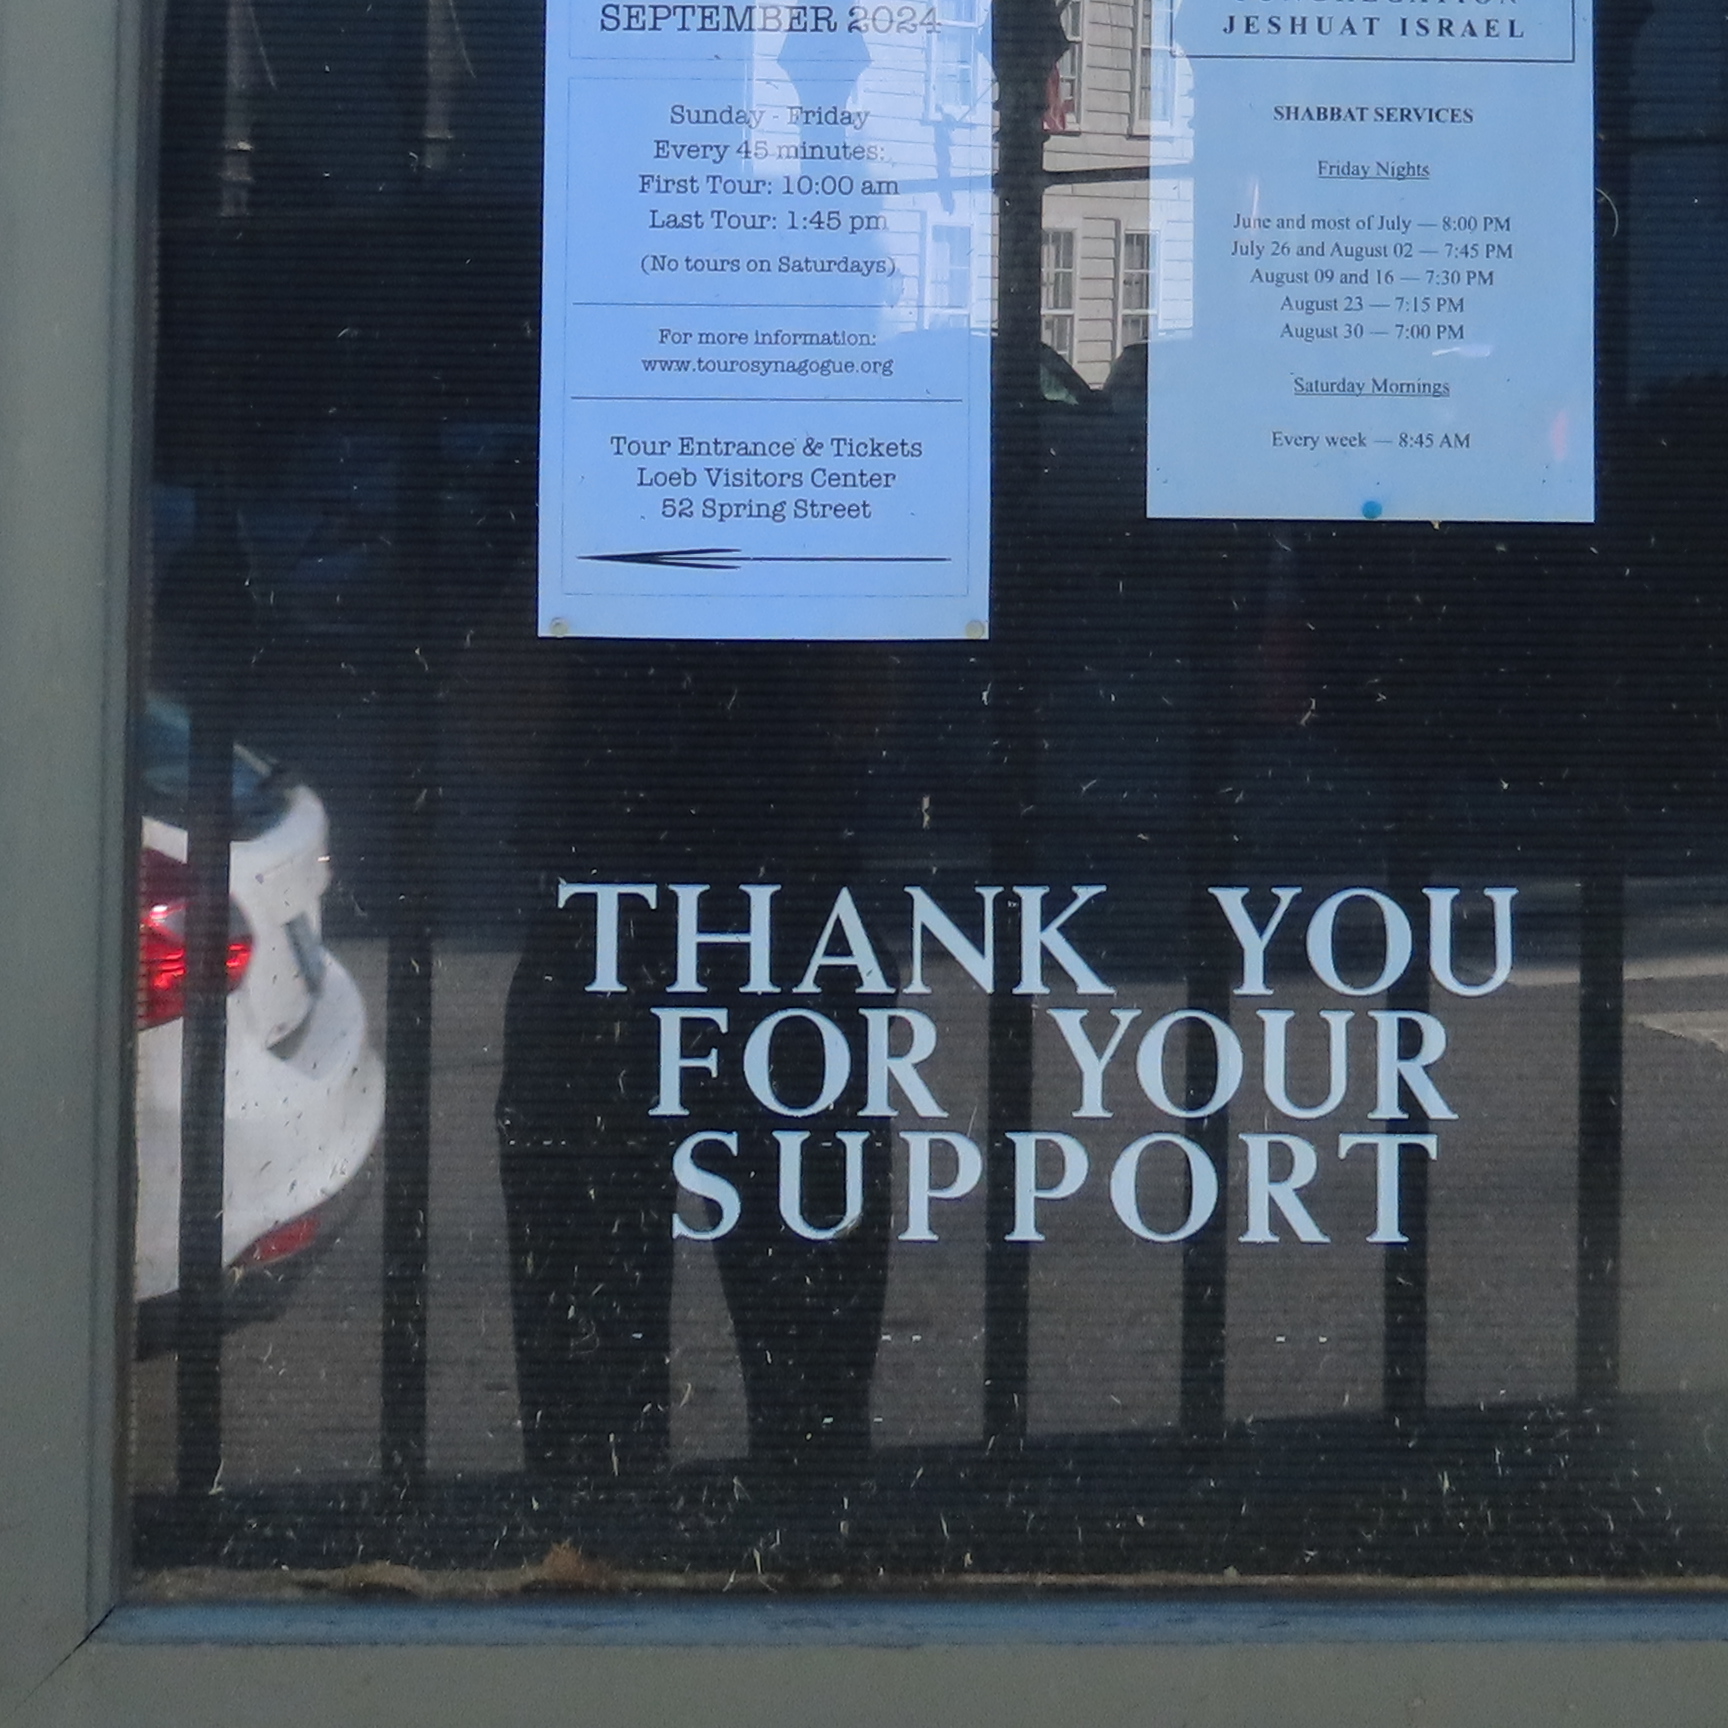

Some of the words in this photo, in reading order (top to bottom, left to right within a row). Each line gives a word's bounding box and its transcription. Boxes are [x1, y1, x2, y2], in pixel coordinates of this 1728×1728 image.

[600, 4, 837, 34] SEPTEMBER
[848, 6, 941, 34] 2024
[1223, 15, 1381, 36] JESHUAT
[1400, 18, 1525, 38] ISRAEL
[670, 105, 765, 129] Sunday
[787, 106, 870, 130] Friday
[1273, 106, 1369, 123] SHABBAT
[1374, 107, 1474, 124] SERVICES
[653, 140, 729, 163] Every
[736, 140, 769, 160] 45
[777, 141, 885, 160] minutes:
[1318, 161, 1370, 180] Friday
[1376, 161, 1430, 180] Nights
[639, 175, 699, 196] First
[706, 175, 772, 196] Tour:
[782, 175, 854, 196] 10:00
[861, 179, 900, 196] am
[649, 210, 704, 230] Last
[710, 210, 777, 230] Tour:
[786, 210, 842, 230] 1:45
[849, 214, 888, 235] pm
[1233, 214, 1271, 232] June
[1276, 214, 1306, 230] and
[1311, 217, 1350, 231] most
[1355, 214, 1375, 231] of
[1376, 214, 1412, 234] July
[1442, 215, 1478, 233] 8:00
[1483, 216, 1511, 233] PM
[1231, 240, 1265, 259] July
[1270, 241, 1291, 257] 26
[1296, 241, 1326, 258] and
[1330, 241, 1389, 261] August
[1393, 242, 1413, 258] 02
[1444, 243, 1480, 259] 7:45
[1485, 243, 1513, 259] PM
[640, 253, 679, 275] (No
[684, 257, 740, 274] tours
[746, 259, 771, 274] on
[778, 254, 897, 276] Saturdays)
[1250, 268, 1309, 287] August
[1314, 269, 1335, 285] 09
[1340, 269, 1369, 285] and
[1376, 269, 1394, 285] 16
[1425, 270, 1461, 286] 7:30
[1466, 270, 1494, 286] PM
[1280, 296, 1338, 315] August
[1343, 296, 1363, 312] 23
[1395, 296, 1430, 313] 7:15
[1436, 297, 1464, 313] PM
[659, 329, 692, 346] For
[698, 332, 748, 346] more
[754, 329, 876, 346] information:
[1280, 323, 1338, 342] August
[1343, 324, 1363, 339] 30
[1395, 324, 1430, 340] 7:00
[1436, 324, 1464, 340] PM
[641, 356, 893, 377] www.tourosynagogue.org
[1293, 377, 1365, 397] Saturday
[1371, 378, 1450, 397] Mornings
[610, 436, 672, 457] Tour
[678, 436, 795, 457] Entrance
[802, 438, 824, 457] &
[830, 437, 922, 458] Tickets
[1272, 432, 1320, 450] Every
[1325, 431, 1367, 448] week
[1398, 432, 1434, 449] 8:45
[1439, 432, 1470, 449] AM
[637, 467, 697, 488] Loeb
[705, 467, 803, 488] Visitors
[810, 467, 896, 488] Center
[661, 498, 694, 519] 52
[702, 498, 786, 522] Spring
[793, 498, 871, 519] Street
[557, 880, 1115, 997] THANK
[1210, 884, 1518, 998] YOU
[650, 1007, 945, 1121] FOR
[1048, 1007, 1457, 1122] YOUR
[672, 1130, 1437, 1244] SUPPORT
